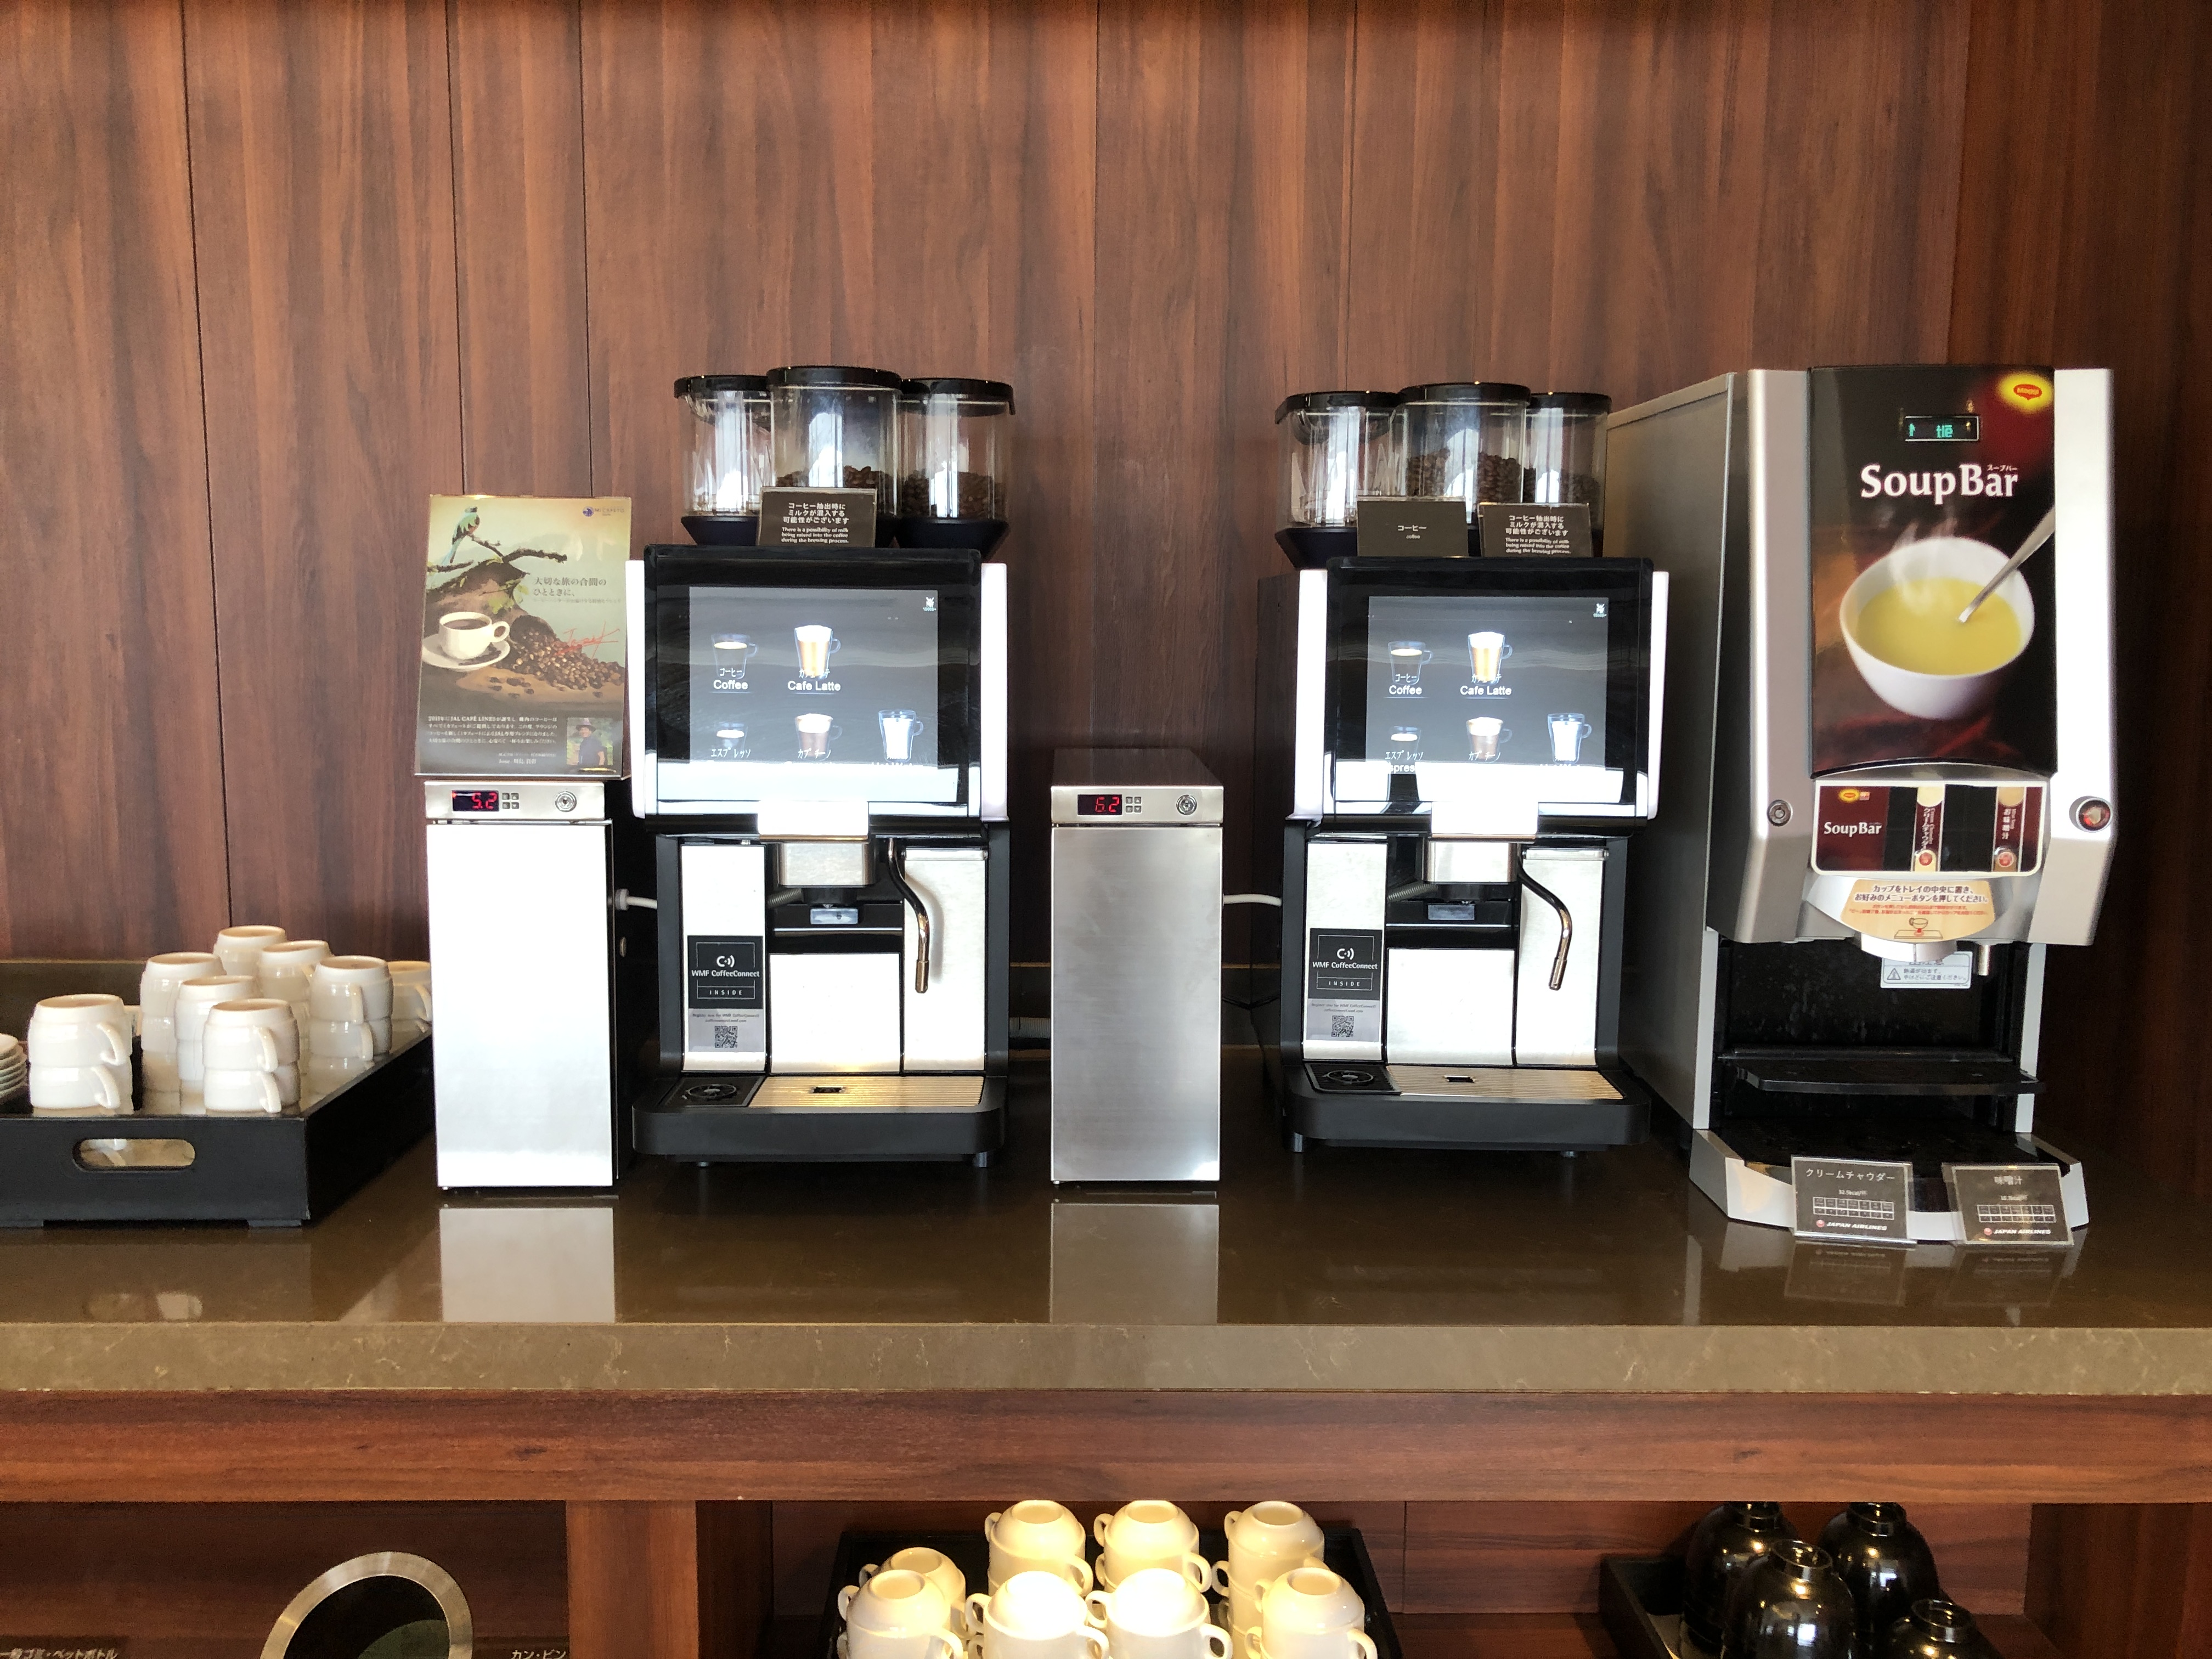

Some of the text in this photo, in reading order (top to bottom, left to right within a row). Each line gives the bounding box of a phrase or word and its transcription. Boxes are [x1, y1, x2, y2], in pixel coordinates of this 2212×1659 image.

[1987, 464, 2018, 472] スープバー
[534, 577, 606, 586] 大切な旅の合間の
[720, 668, 742, 677] コーヒー
[1395, 673, 1417, 682] コーヒー
[713, 680, 748, 690] Coffee
[788, 681, 841, 691] Cafe Latte
[1389, 685, 1422, 695] Coffee
[1460, 686, 1512, 695] Cafe Latte
[1873, 885, 1973, 894] カップをトレイの中央に置き、
[1855, 894, 1988, 902] お好みのメニューボタンを押してください。
[1806, 1169, 1894, 1181] クリームチャウダー
